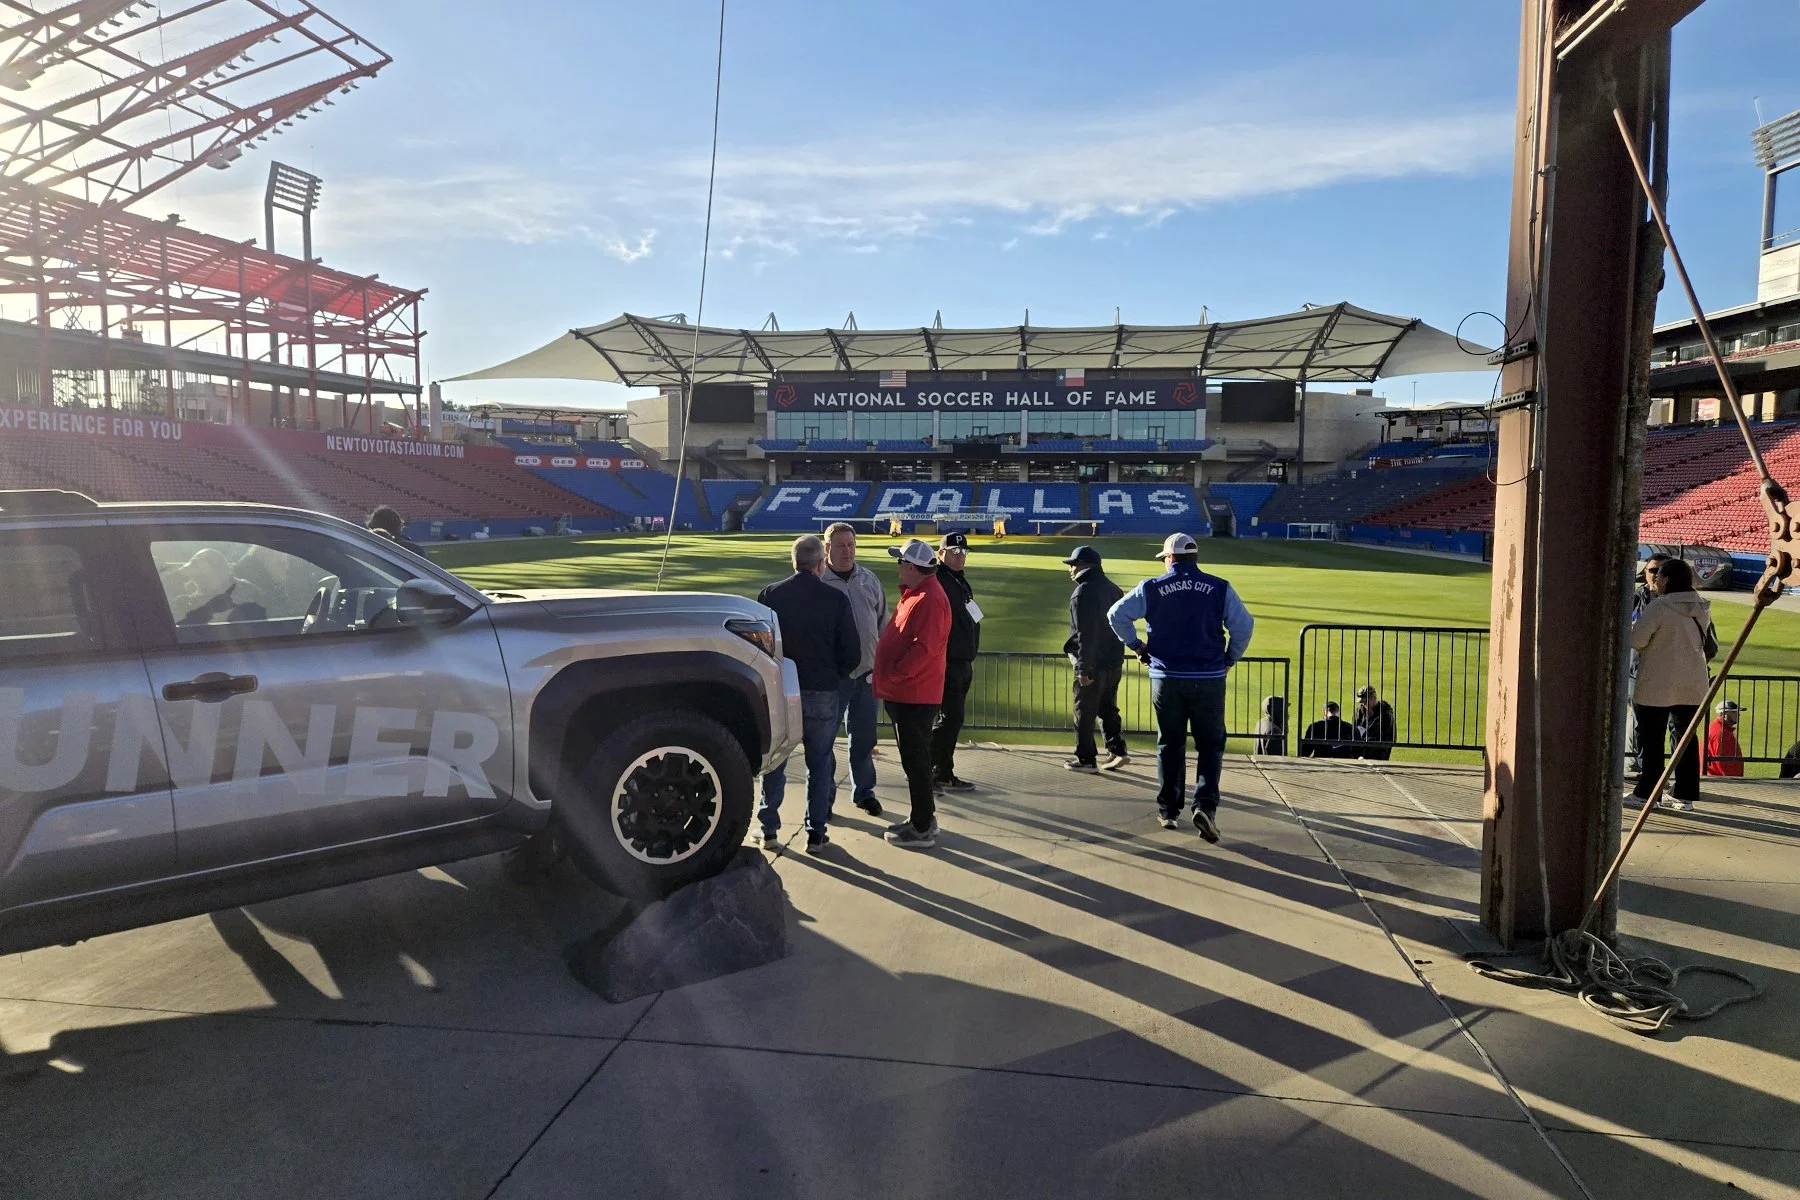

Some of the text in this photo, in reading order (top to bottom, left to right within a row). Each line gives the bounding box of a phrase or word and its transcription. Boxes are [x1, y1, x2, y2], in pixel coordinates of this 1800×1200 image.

[813, 391, 1156, 406] NATIONAL SOCCER HALL OF FAME
[113, 418, 144, 437] FOR
[150, 420, 182, 440] YOU
[326, 435, 464, 458] NEWTOYOTASTADIUM.COM
[766, 487, 1189, 515] FC DALLAS
[955, 535, 963, 545] P
[1158, 579, 1214, 597] KANSAS CITY
